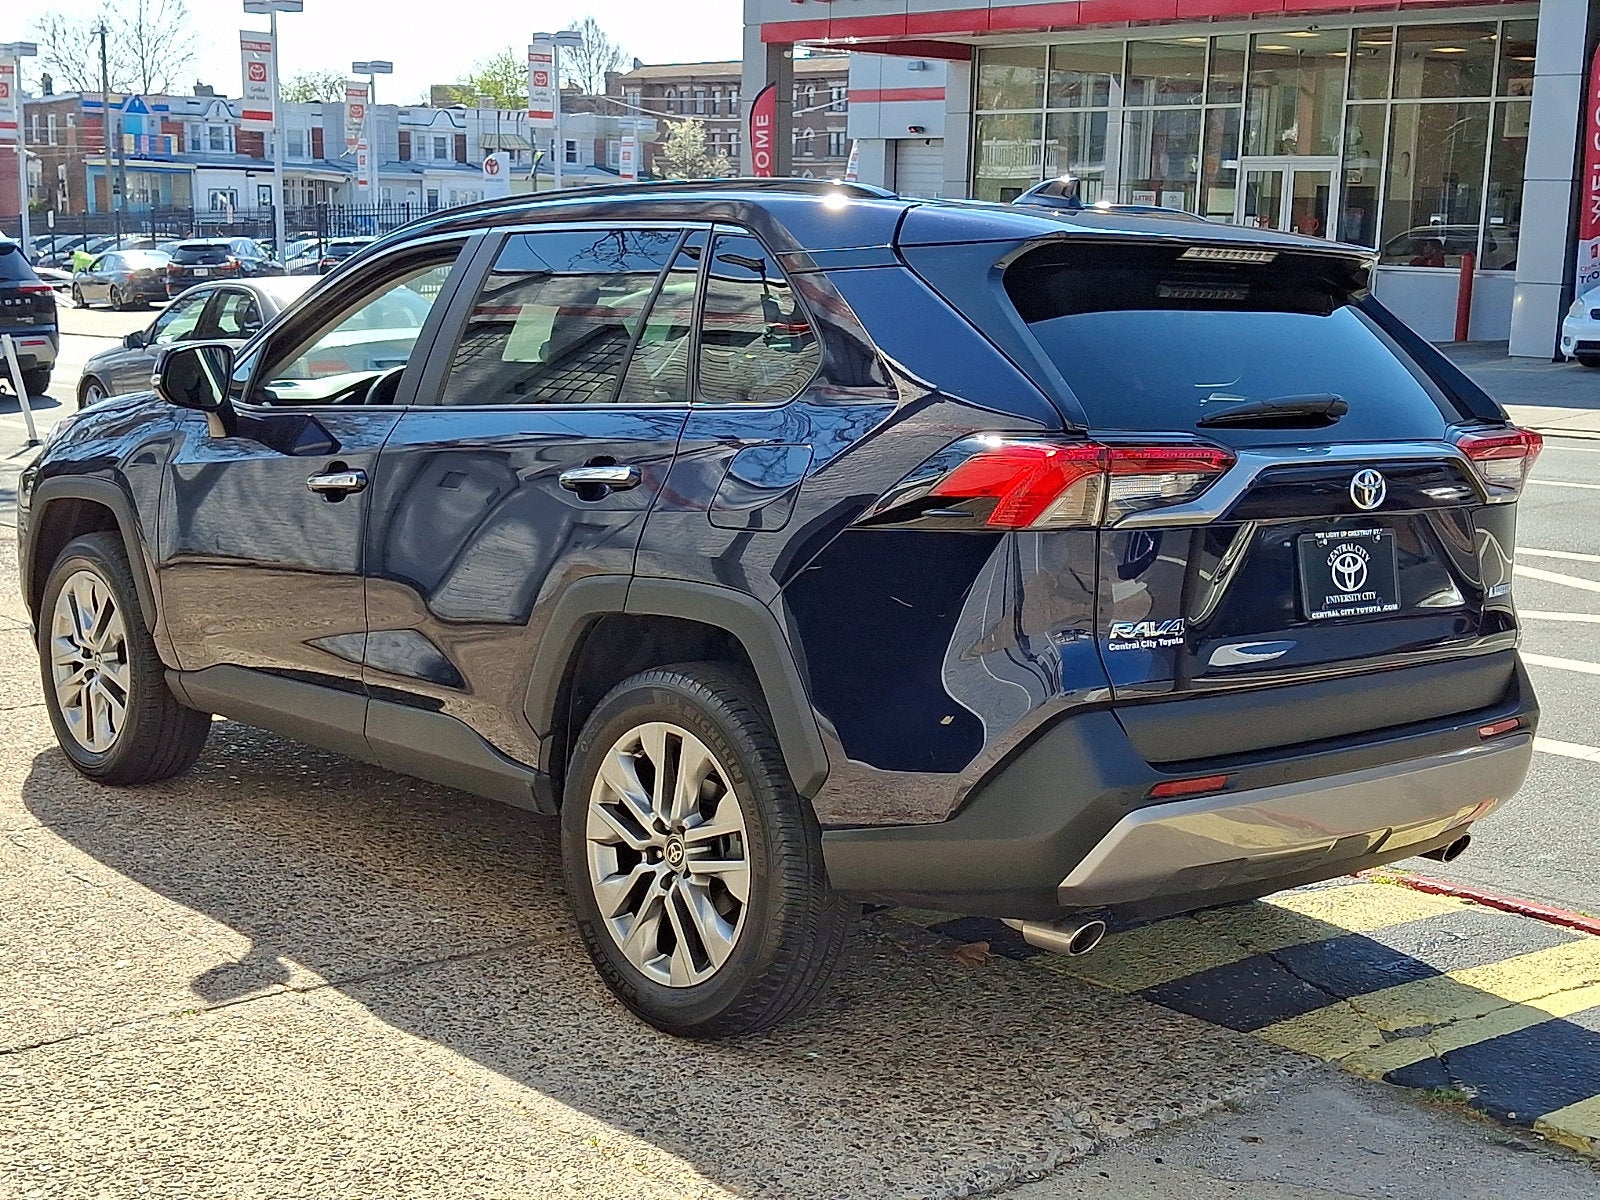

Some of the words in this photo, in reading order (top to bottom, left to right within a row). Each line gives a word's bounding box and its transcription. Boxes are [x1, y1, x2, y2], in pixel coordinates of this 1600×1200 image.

[756, 114, 770, 177] OME
[1327, 543, 1355, 567] CENTRAL
[1354, 544, 1371, 563] CITY
[1325, 592, 1361, 604] UNIVERSITY
[1361, 591, 1377, 601] CITY
[1311, 609, 1340, 619] CENTRAL
[1340, 608, 1355, 616] CITY
[1356, 605, 1382, 615] TOYOTA
[1108, 618, 1185, 639] RAV4
[1108, 641, 1140, 651] Central
[1140, 639, 1157, 649] City
[1157, 637, 1184, 647] Toyota
[681, 704, 743, 780] MICHELIN
